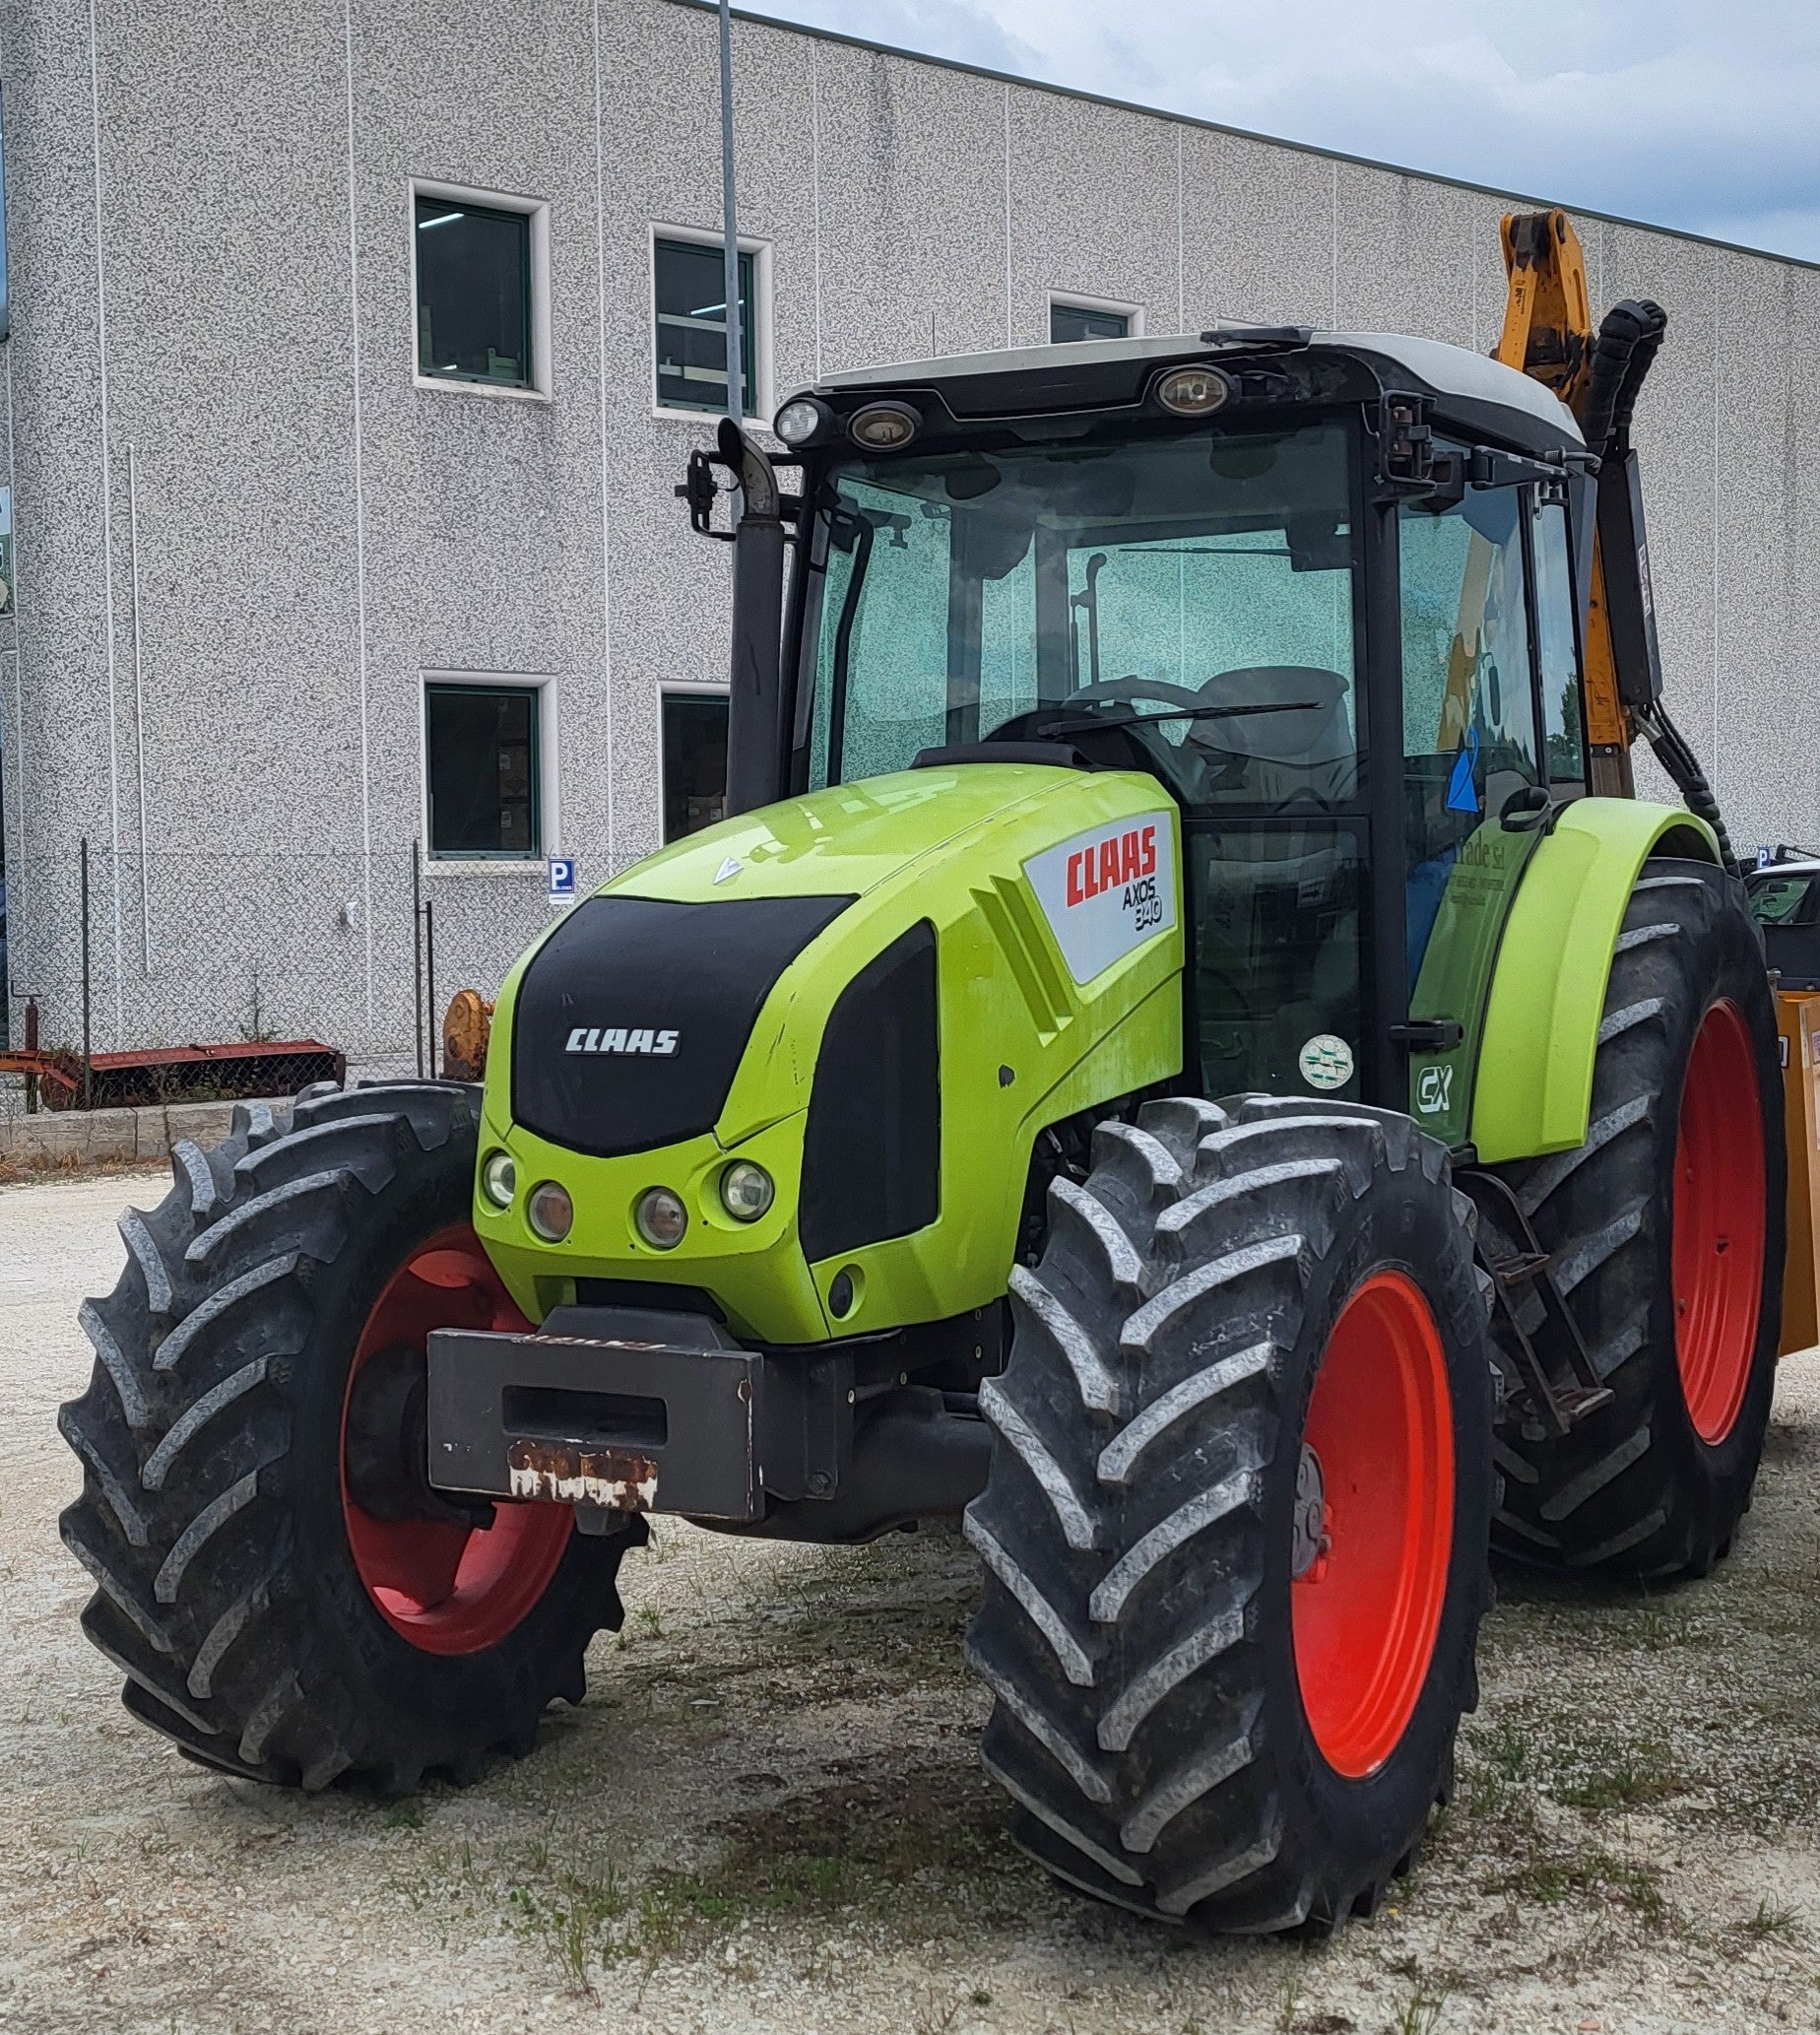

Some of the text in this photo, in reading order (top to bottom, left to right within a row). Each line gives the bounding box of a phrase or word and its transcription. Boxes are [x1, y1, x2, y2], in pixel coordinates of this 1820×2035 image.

[1066, 825, 1156, 908] CLAAS
[1759, 849, 1768, 868] P
[551, 862, 568, 890] P
[1122, 876, 1156, 911] AXOS
[564, 1028, 680, 1055] CLAAS
[1416, 1064, 1453, 1114] CX
